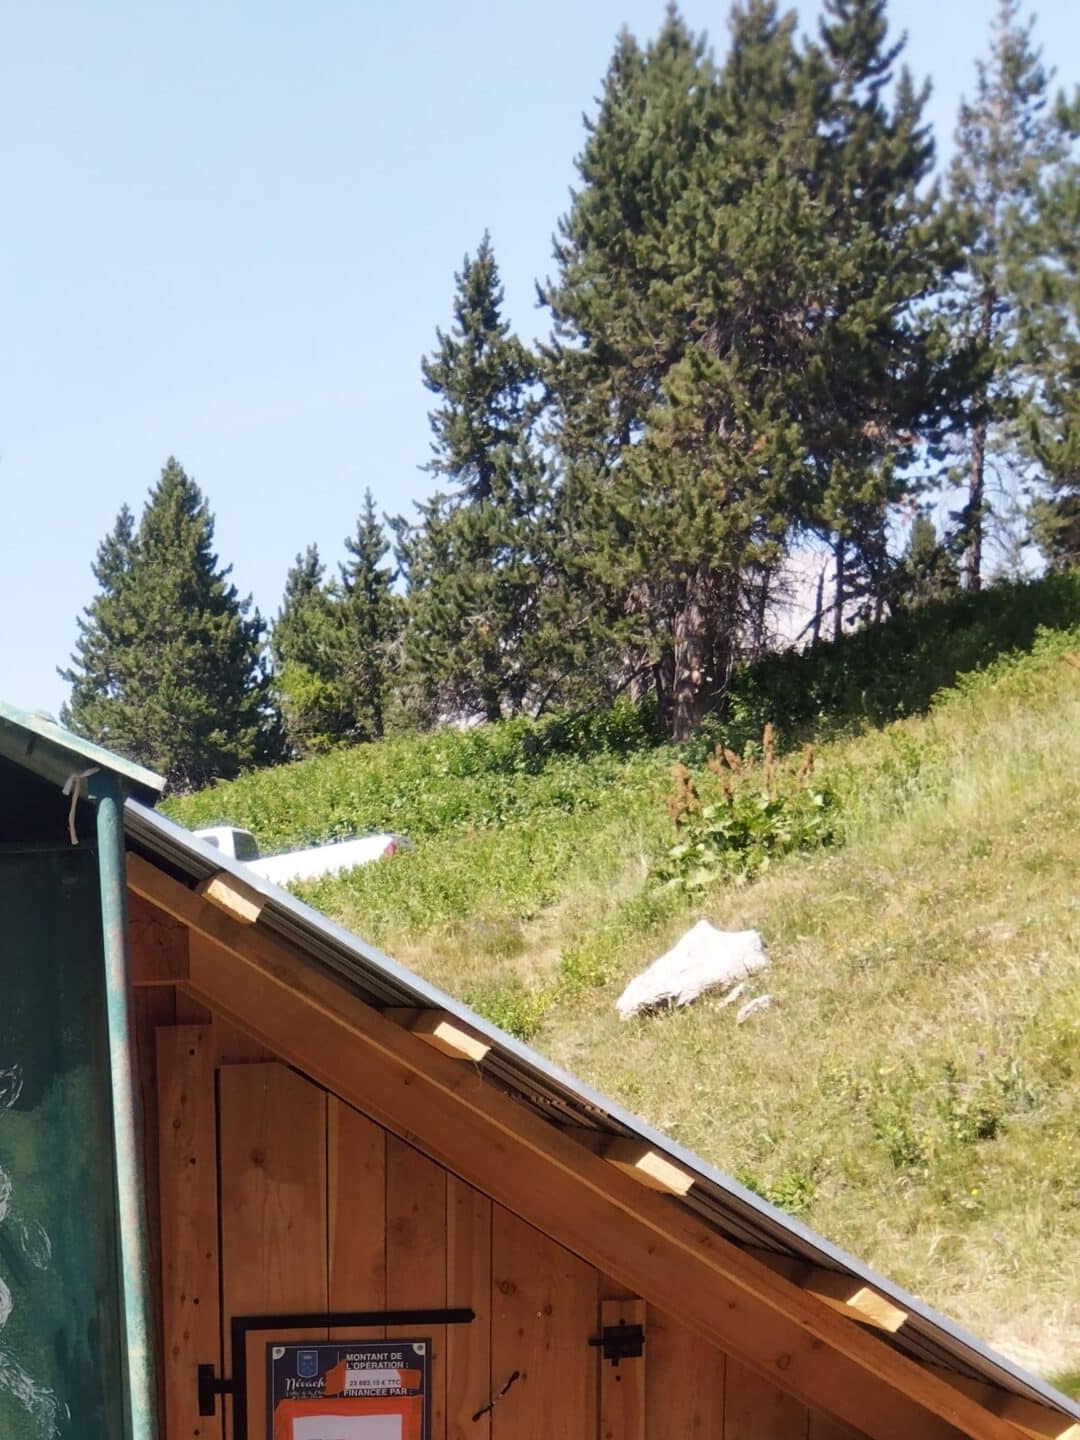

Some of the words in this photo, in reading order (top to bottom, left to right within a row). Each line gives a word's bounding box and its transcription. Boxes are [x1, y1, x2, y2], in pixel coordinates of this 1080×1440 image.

[345, 1353, 389, 1361] MONTANT
[390, 1352, 403, 1360] DE
[285, 1377, 325, 1391] Névach
